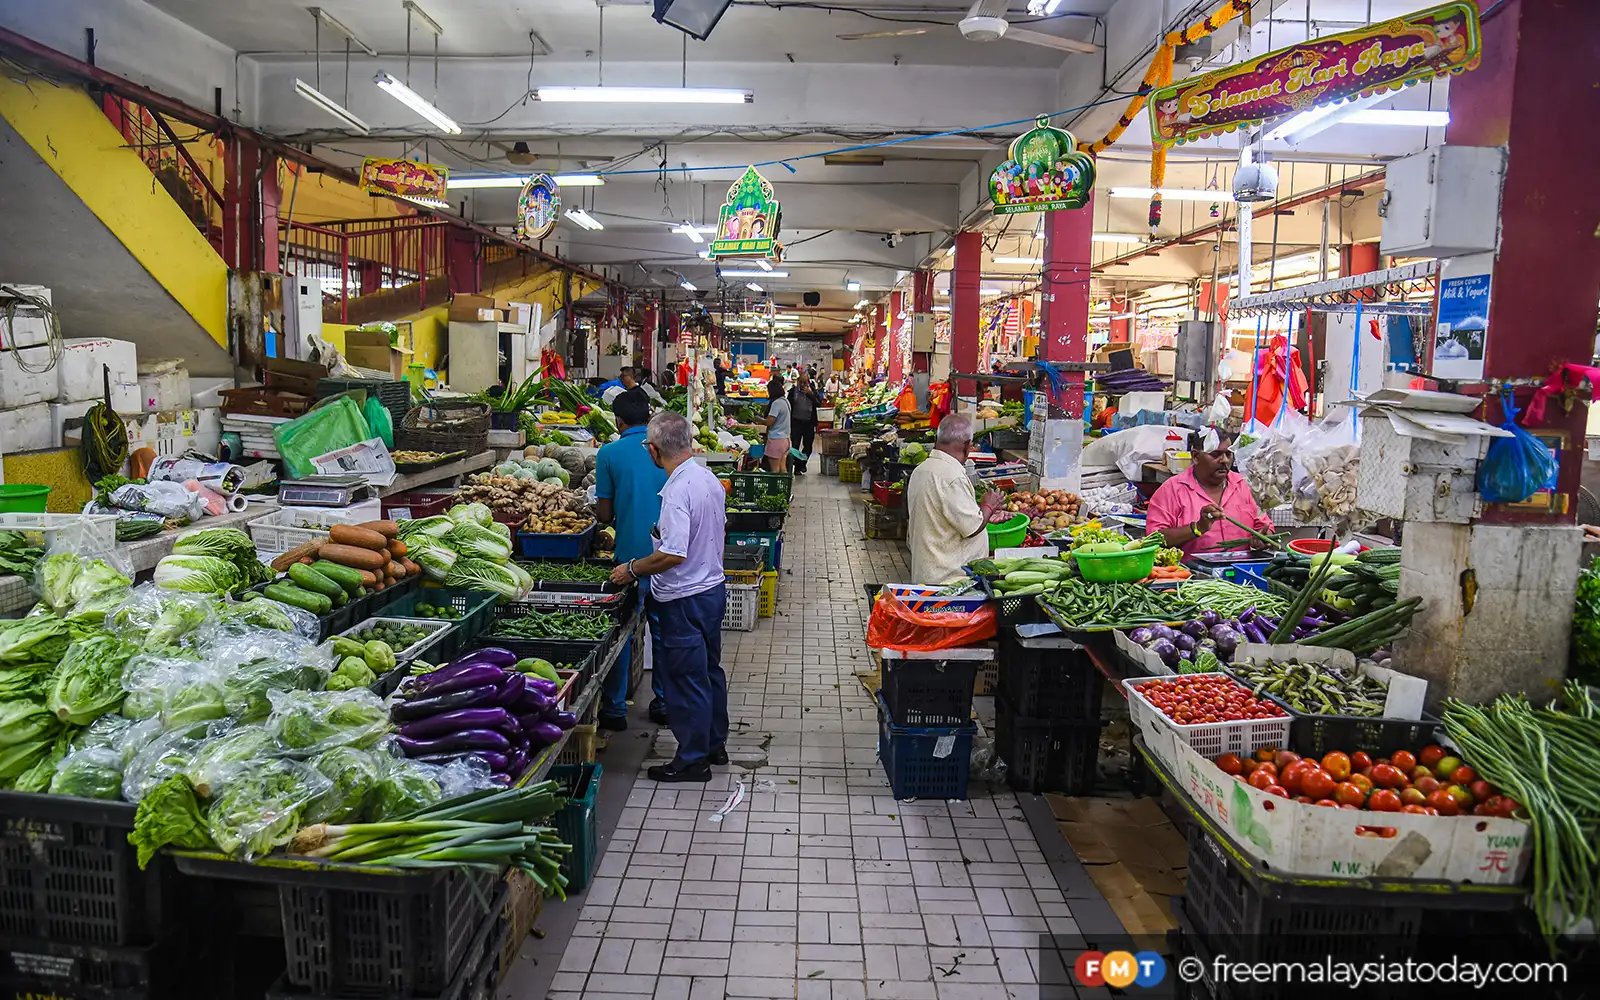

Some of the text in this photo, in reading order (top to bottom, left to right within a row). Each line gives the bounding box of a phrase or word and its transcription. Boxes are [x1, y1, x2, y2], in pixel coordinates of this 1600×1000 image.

[1187, 40, 1426, 118] Selamat Hari Raya
[1005, 205, 1030, 214] SELAMAT
[1457, 286, 1464, 299] &
[1465, 285, 1488, 300] Yogurt
[1486, 835, 1521, 849] YUAN
[1479, 851, 1510, 873] 元
